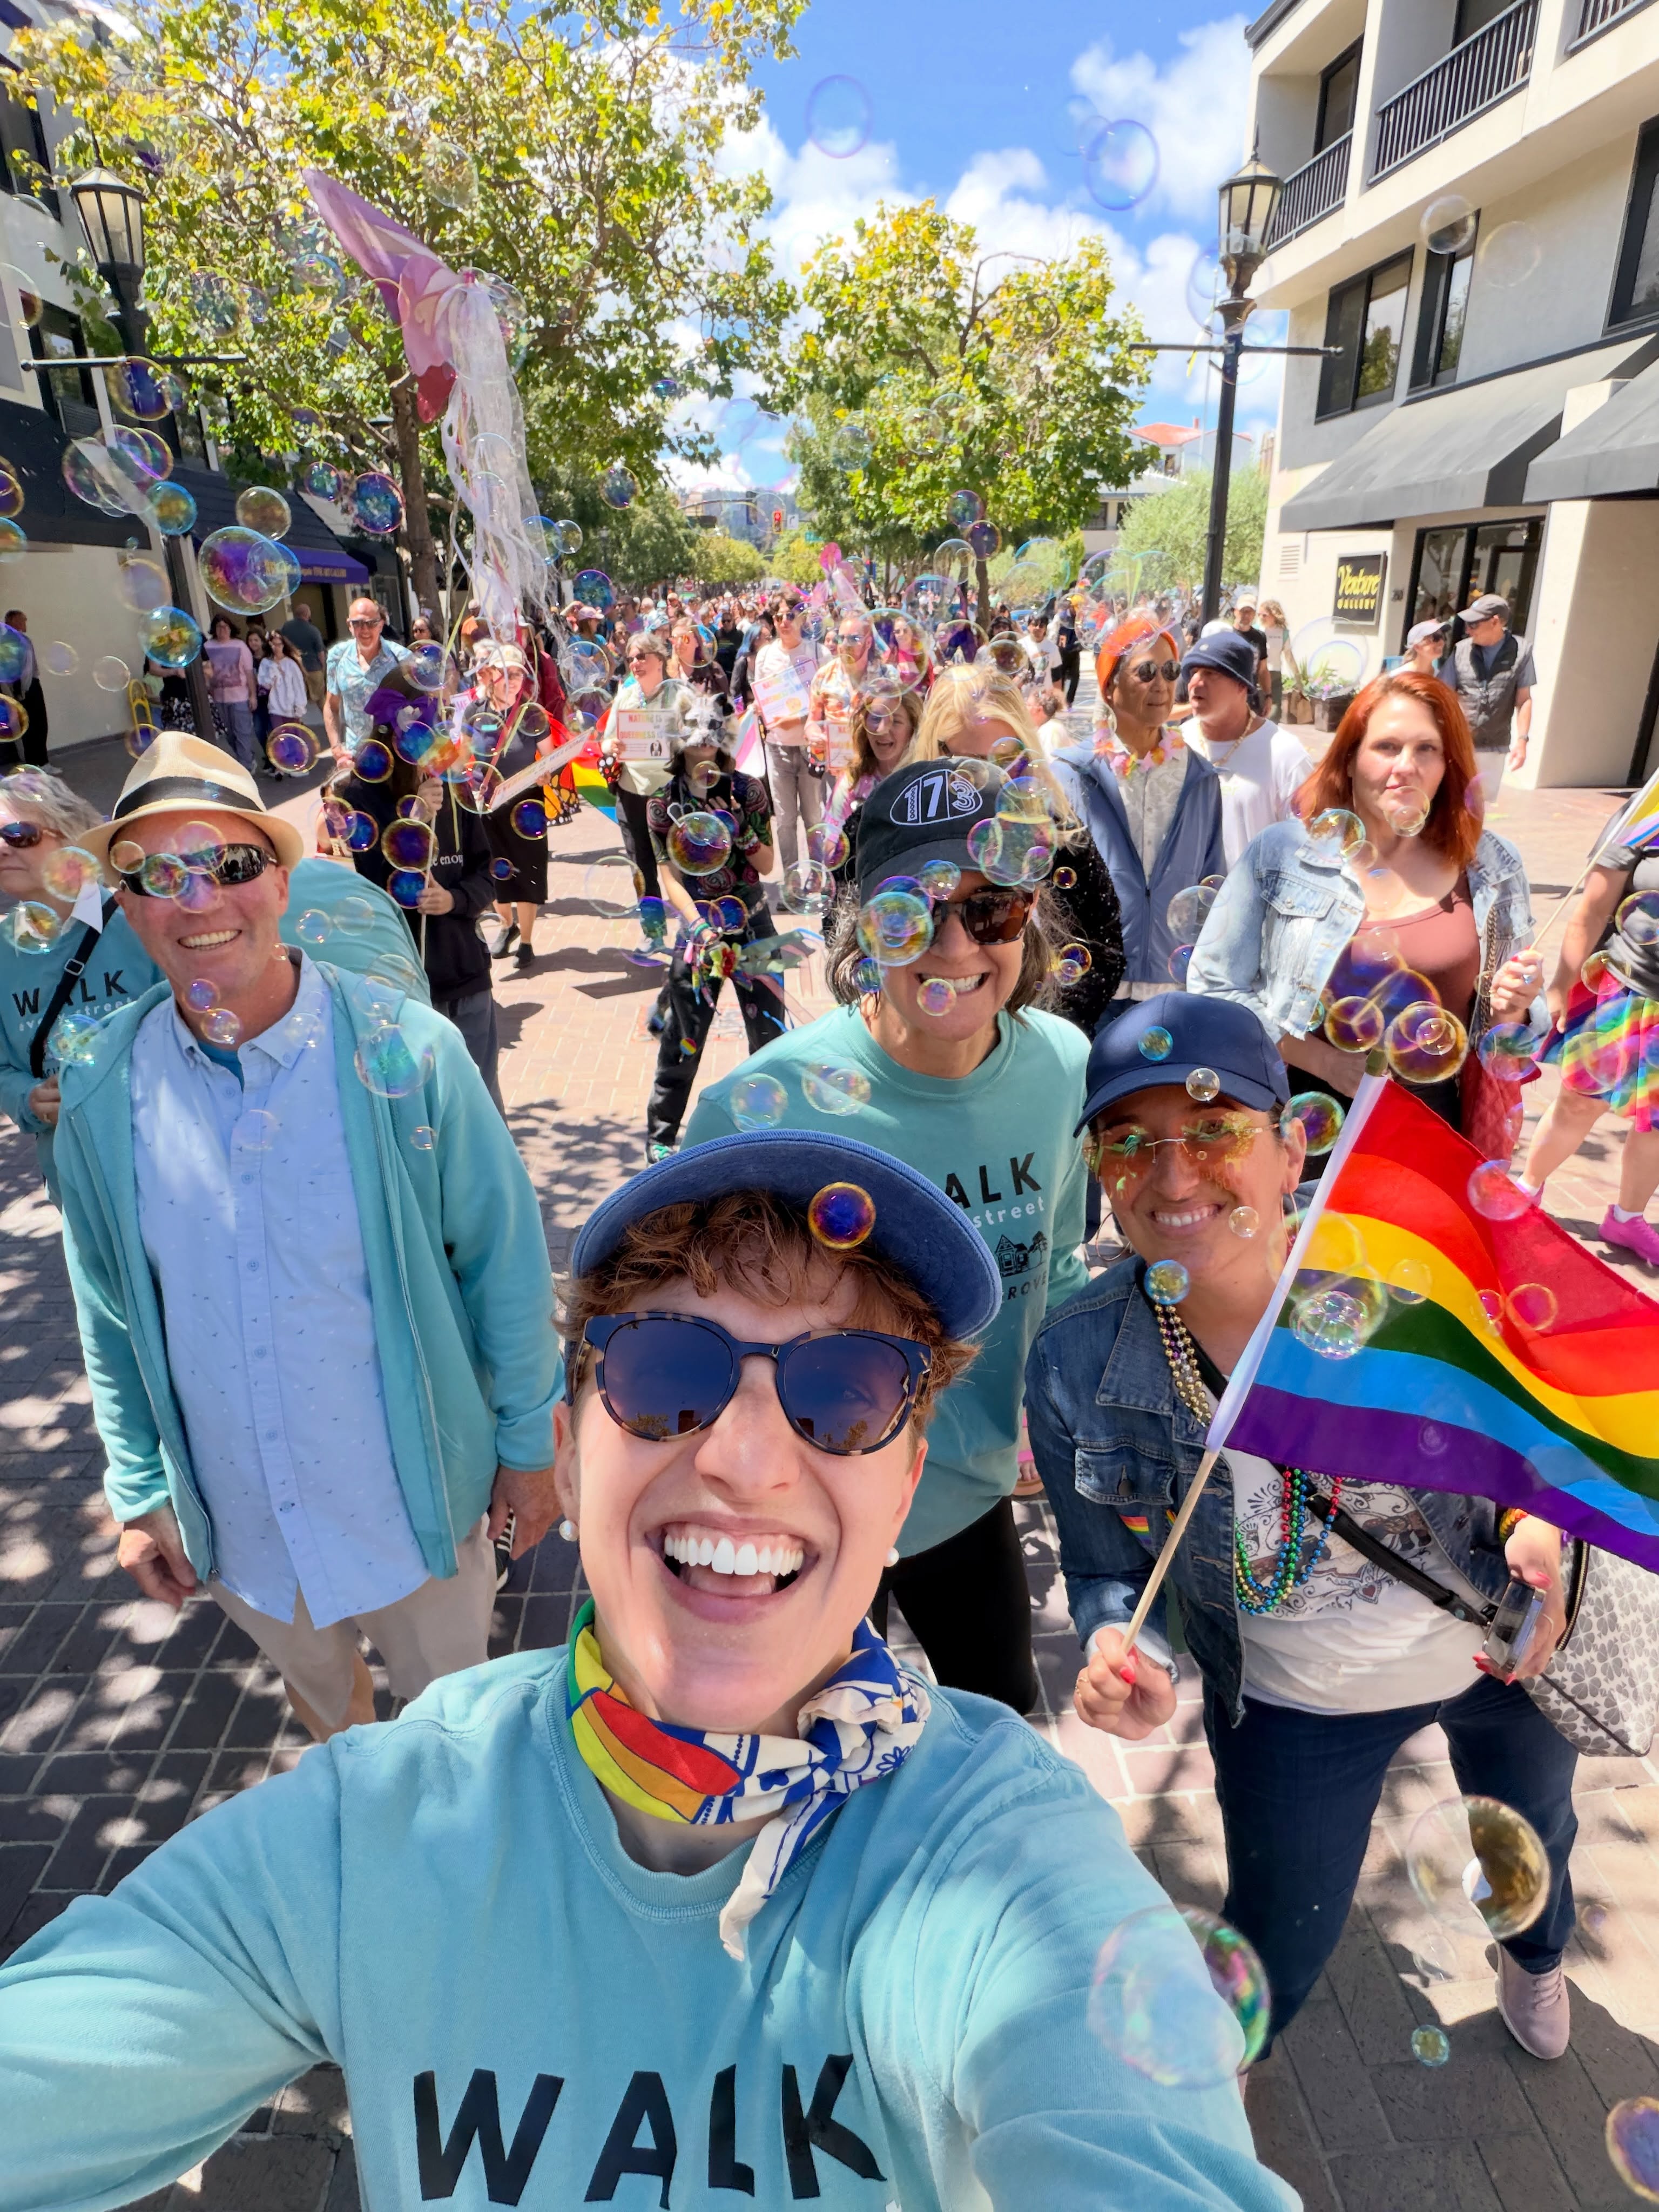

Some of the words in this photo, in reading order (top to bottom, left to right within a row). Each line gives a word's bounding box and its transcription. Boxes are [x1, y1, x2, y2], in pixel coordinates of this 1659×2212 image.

[1338, 564, 1381, 596] Venture
[1337, 598, 1376, 610] GALLERY
[905, 775, 976, 821] 173
[12, 970, 129, 1016] WLK
[945, 1151, 1042, 1209] ALK
[973, 1196, 1045, 1229] street
[414, 2054, 887, 2210] WALK
